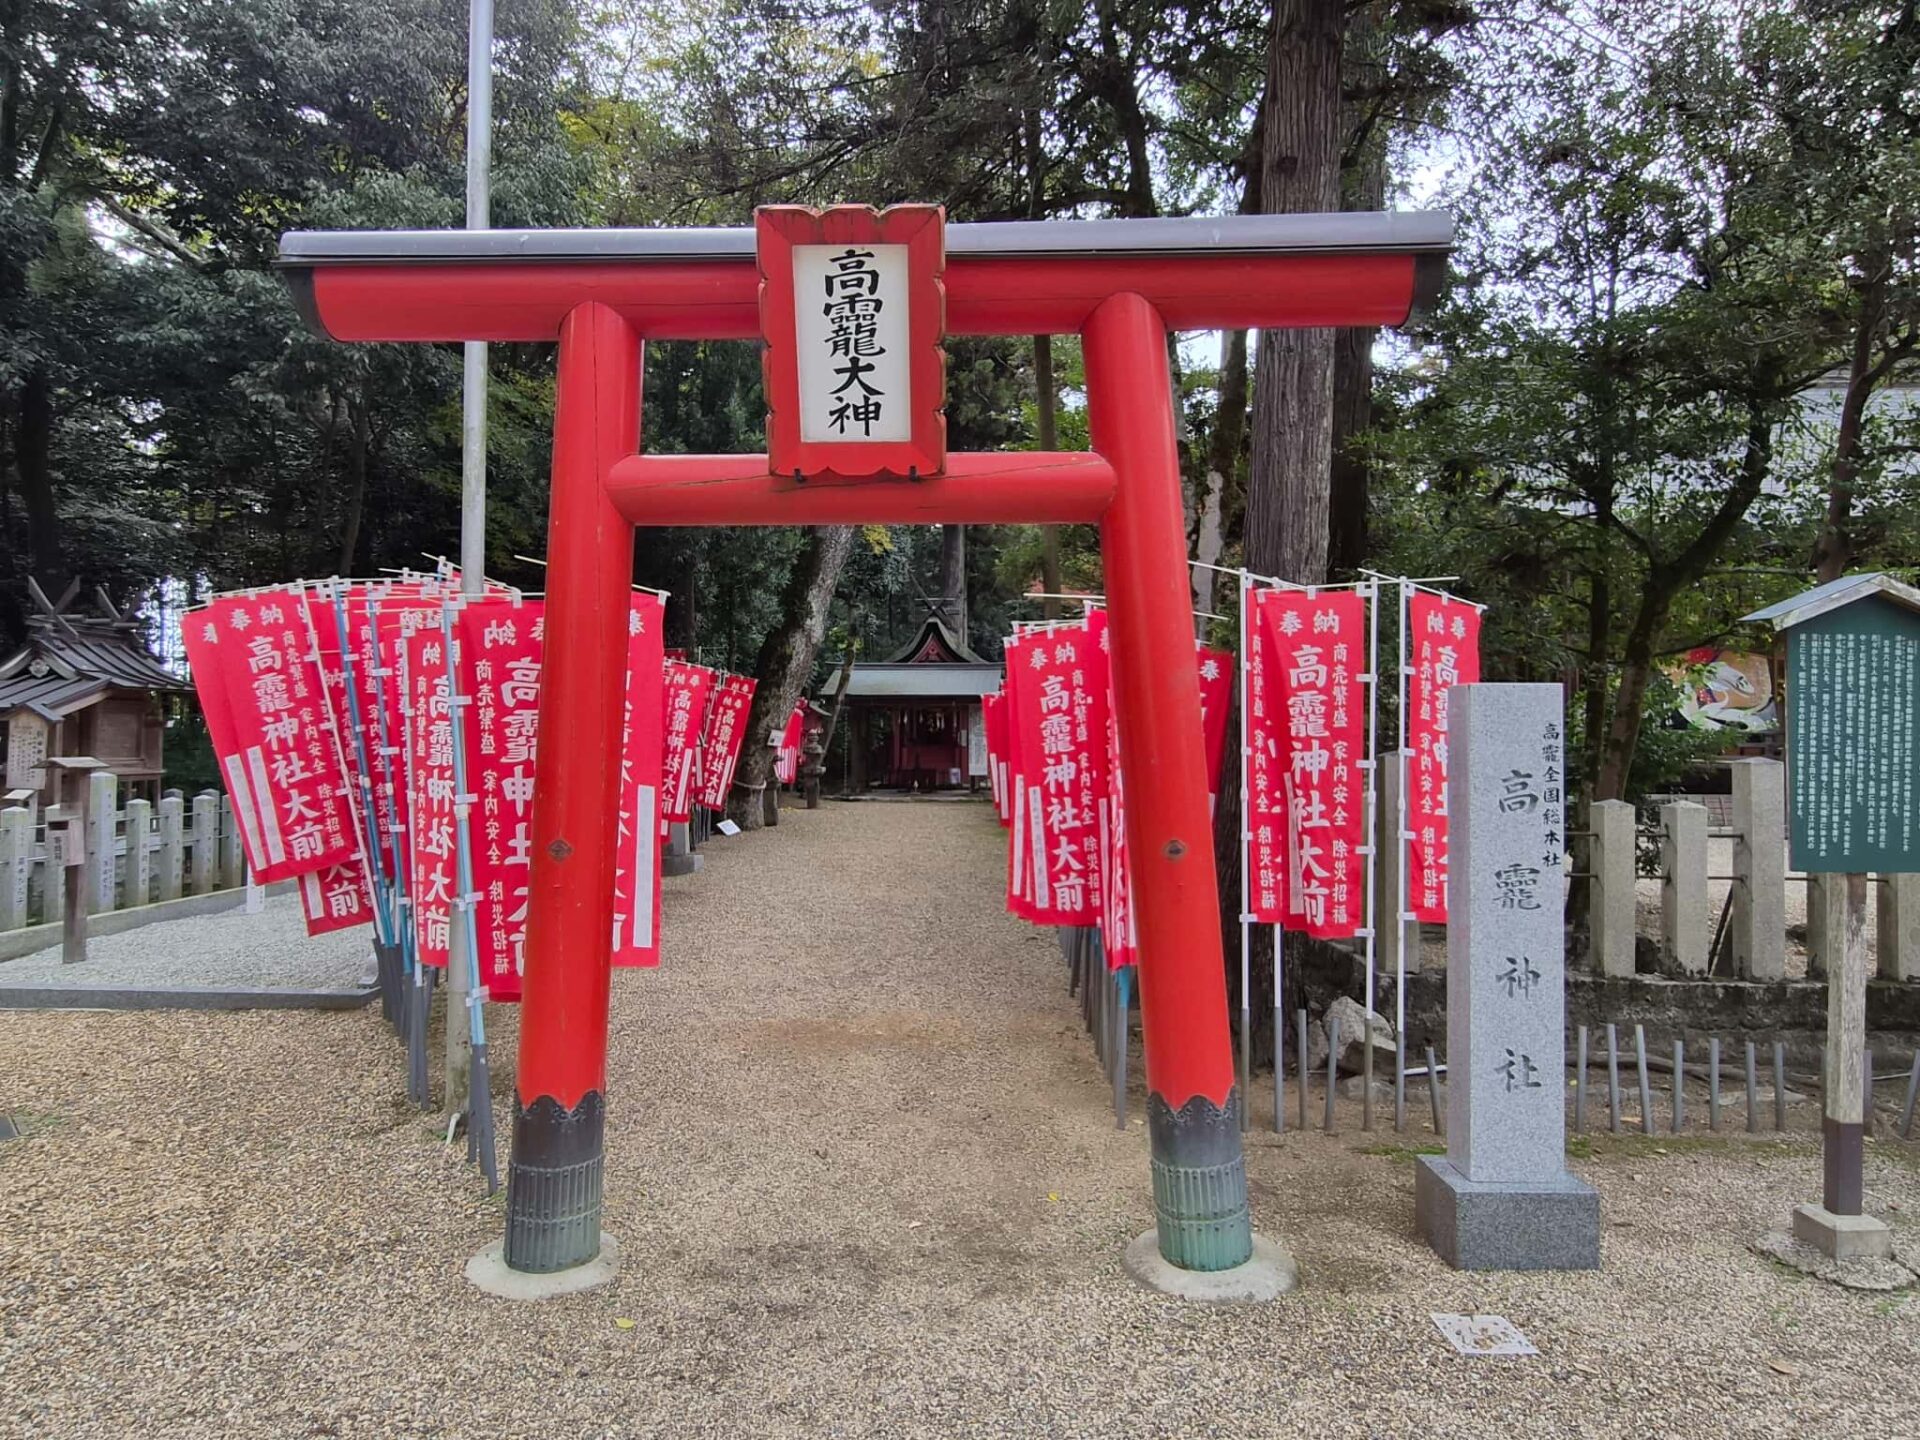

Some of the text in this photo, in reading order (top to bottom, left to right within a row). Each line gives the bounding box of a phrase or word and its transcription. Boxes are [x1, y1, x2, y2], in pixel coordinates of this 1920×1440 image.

[823, 248, 886, 437] 高龗大神
[230, 603, 284, 631] 奉納
[1279, 609, 1340, 637] 奉納
[1030, 642, 1076, 670] 奉納
[1492, 769, 1542, 1093] 高龗神社
